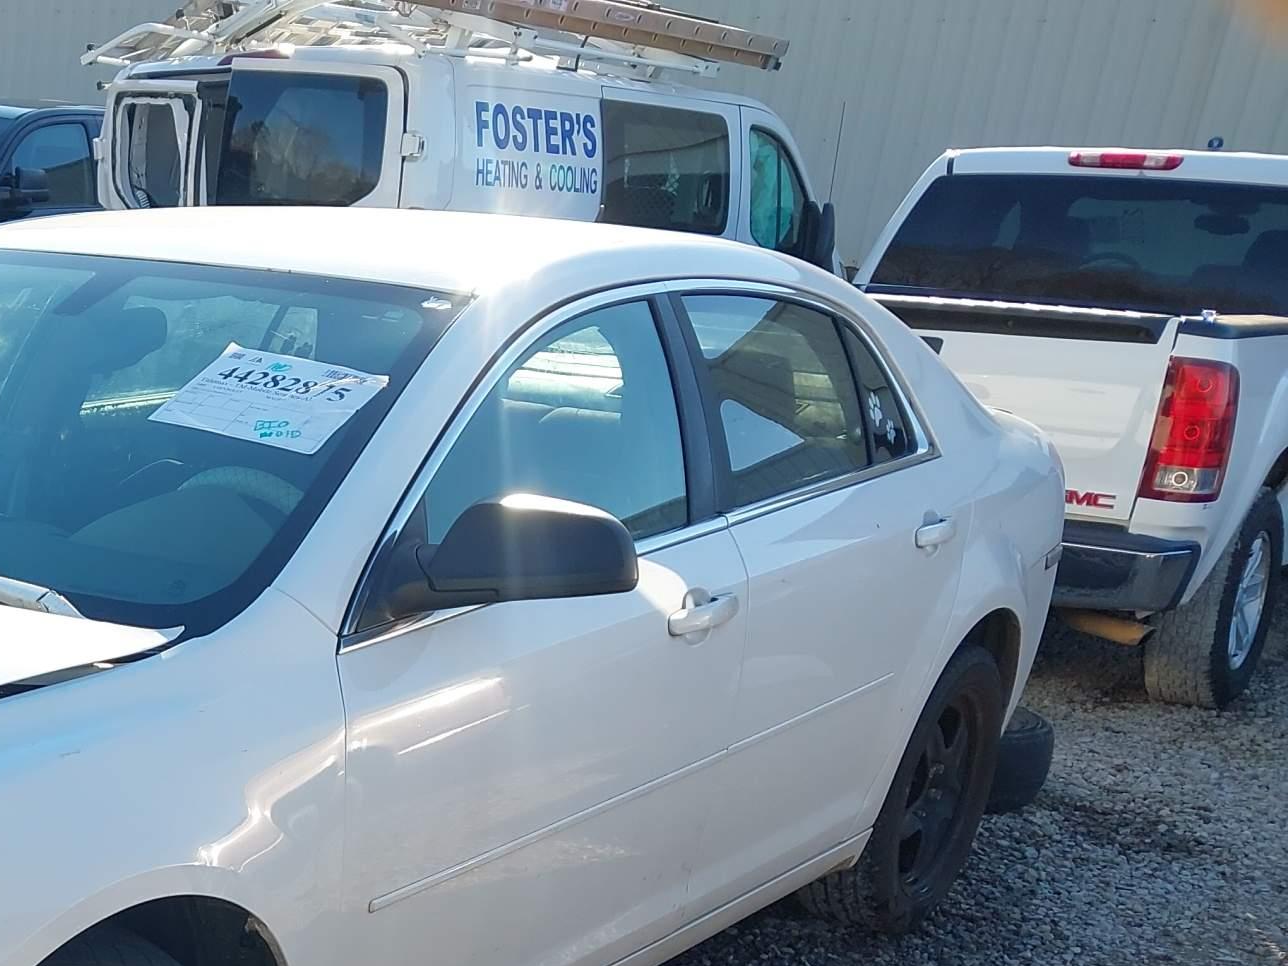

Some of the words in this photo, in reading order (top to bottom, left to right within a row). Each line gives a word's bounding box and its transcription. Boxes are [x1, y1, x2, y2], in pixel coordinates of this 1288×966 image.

[475, 101, 597, 159] FOSTER'S
[475, 158, 528, 190] HEATING
[534, 162, 543, 190] &
[549, 164, 598, 194] COOLING
[217, 366, 353, 402] 44282875
